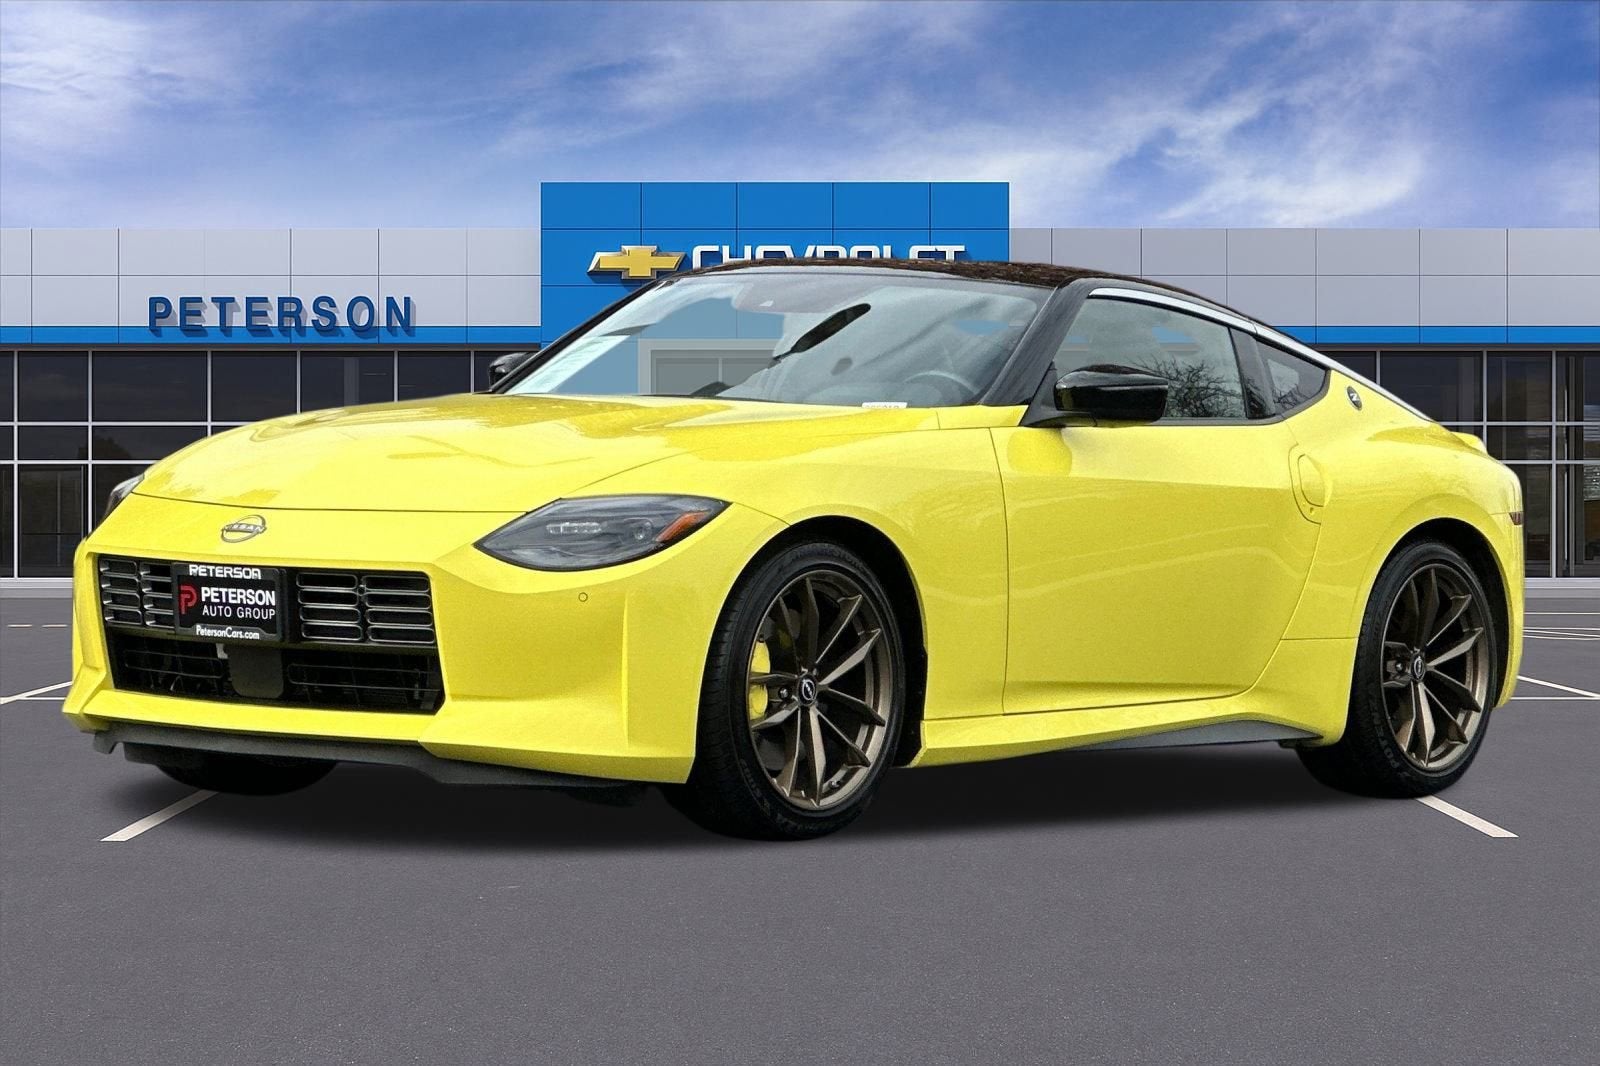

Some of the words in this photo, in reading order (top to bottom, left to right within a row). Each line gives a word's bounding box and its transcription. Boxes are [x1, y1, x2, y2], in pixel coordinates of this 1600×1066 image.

[148, 296, 412, 331] PETERSON
[188, 564, 262, 580] PETERSON
[201, 586, 276, 606] PETERSON
[202, 605, 232, 618] AUTO
[236, 606, 276, 620] GROUP
[195, 624, 260, 640] PetersonCars.com
